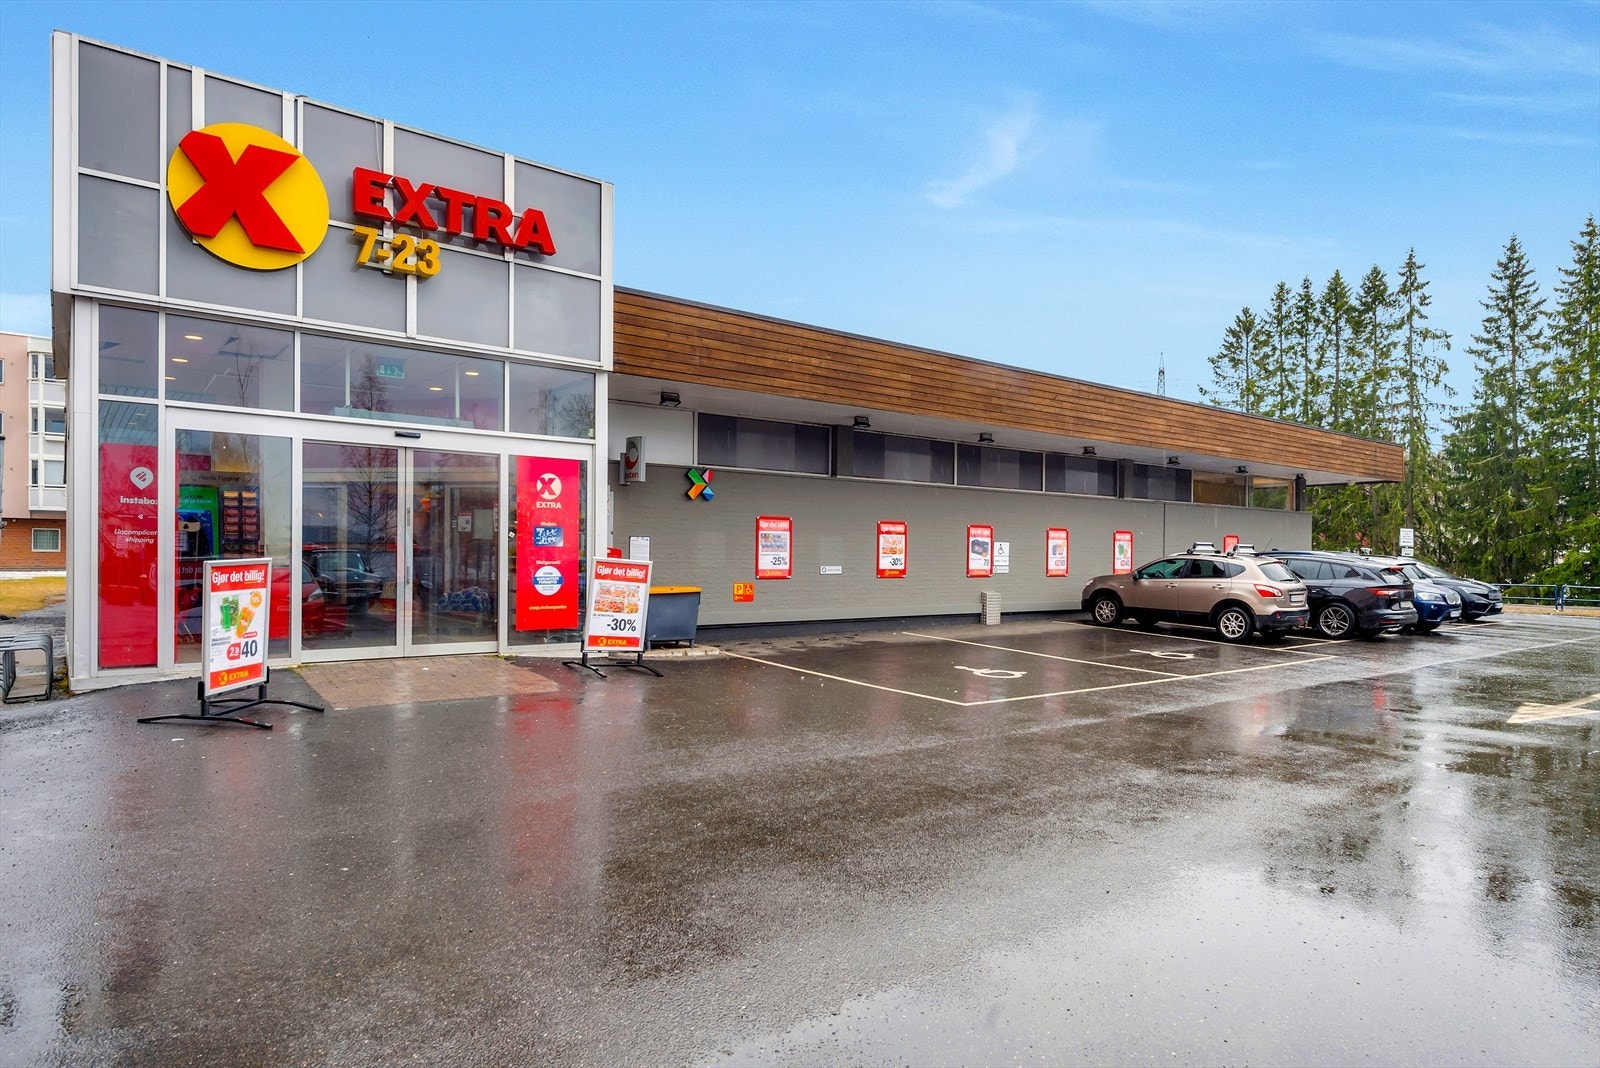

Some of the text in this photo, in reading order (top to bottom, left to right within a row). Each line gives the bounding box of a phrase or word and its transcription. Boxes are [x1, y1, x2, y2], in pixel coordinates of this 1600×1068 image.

[353, 167, 556, 256] EXTRA
[353, 225, 441, 277] 7-23
[536, 501, 562, 509] EXTRA
[770, 556, 788, 566] -25%
[212, 569, 265, 586] Gjør det billig!
[596, 565, 646, 579] Gjør det billig!
[736, 584, 742, 594] P
[606, 617, 637, 632] -30%
[241, 639, 258, 658] 40
[608, 638, 627, 646] EXTRA
[229, 670, 249, 681] EXTRA
